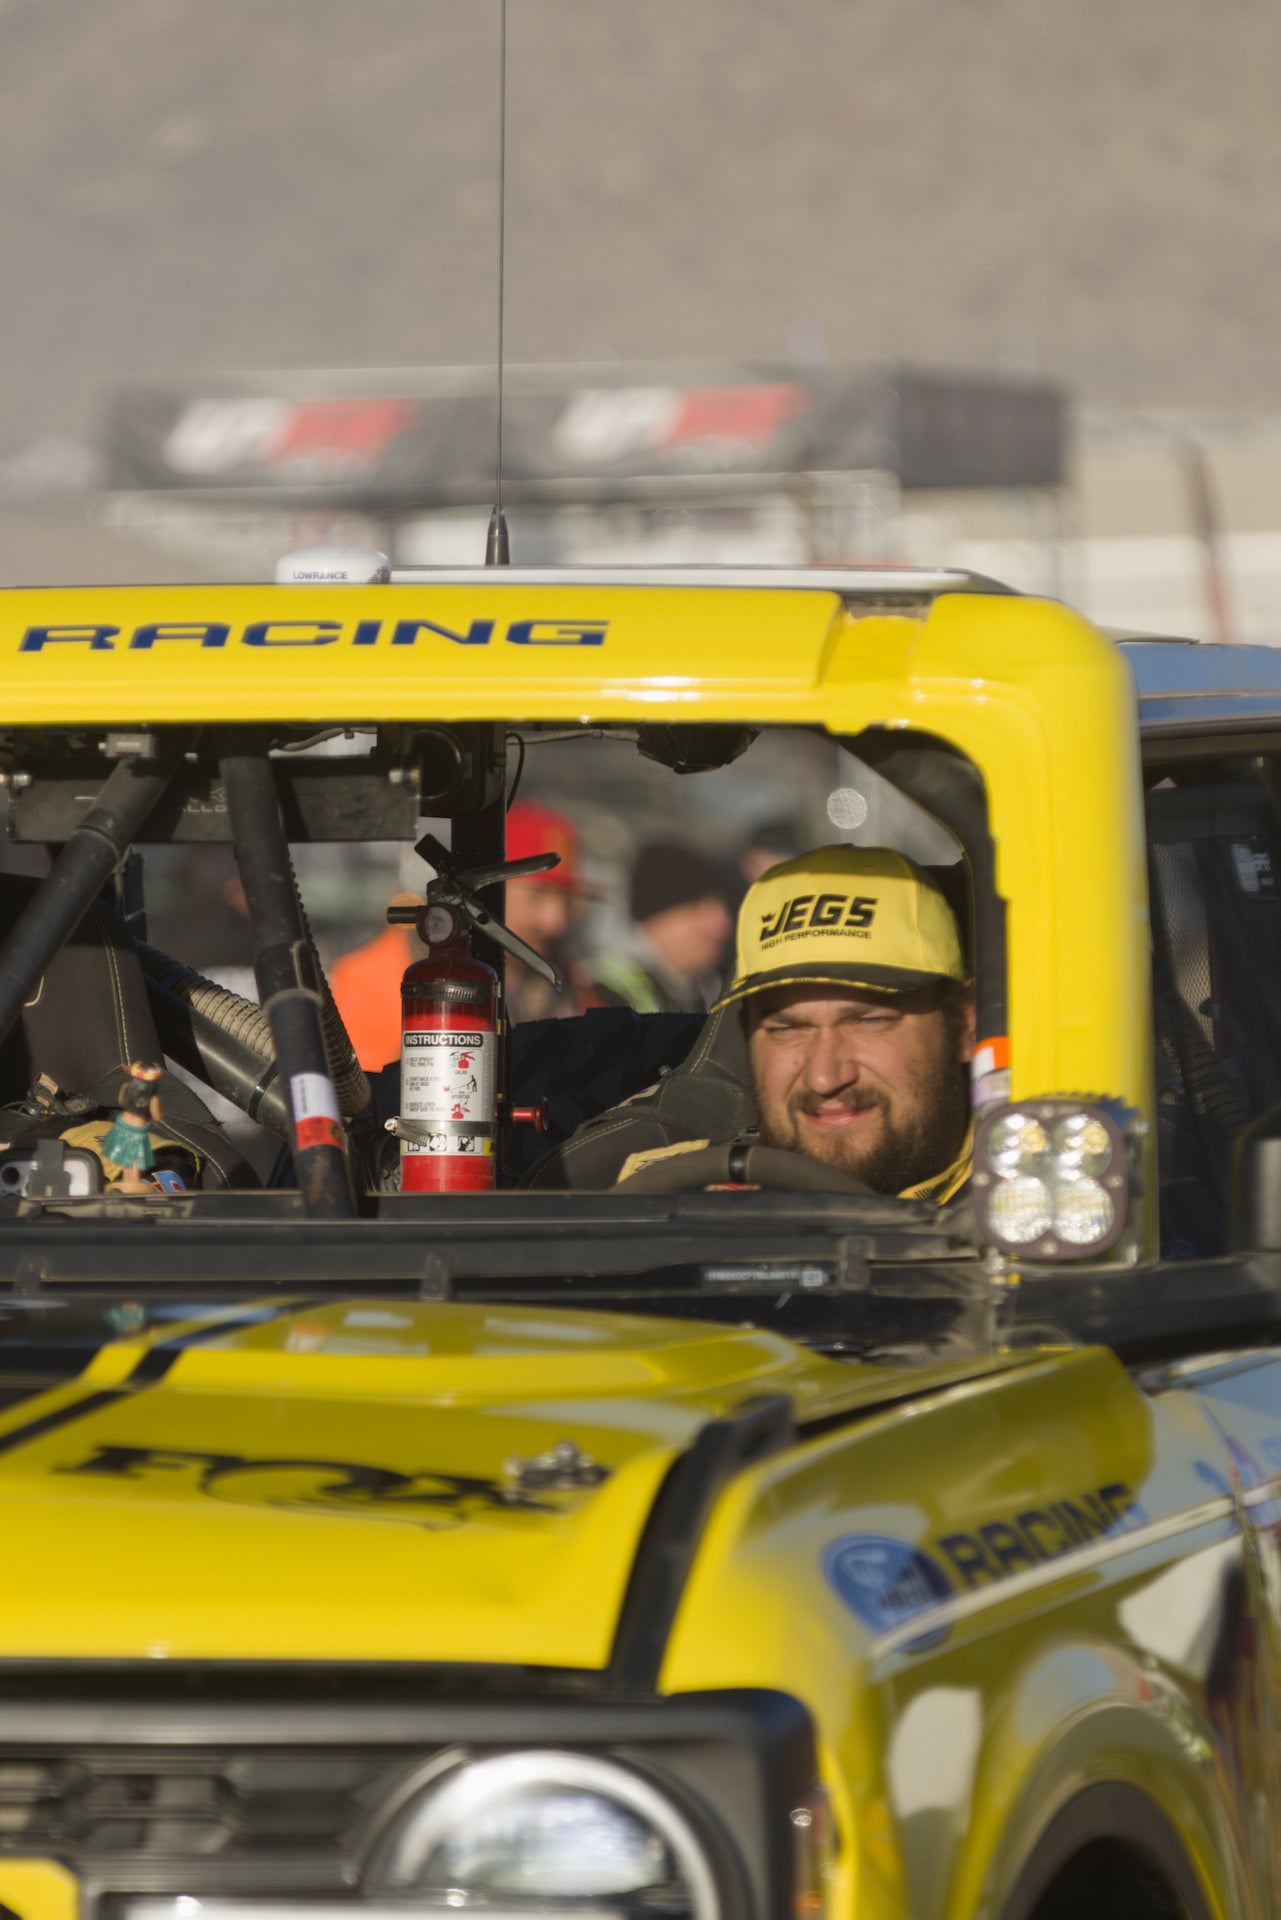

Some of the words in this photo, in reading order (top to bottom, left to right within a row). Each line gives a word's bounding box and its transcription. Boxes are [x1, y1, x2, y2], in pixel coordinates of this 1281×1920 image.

[293, 571, 348, 580] LOWRANCE
[18, 618, 610, 652] RACING
[759, 893, 879, 942] JEGS
[761, 937, 782, 952] HIGH
[784, 928, 872, 943] PERFORMANCE
[406, 1034, 481, 1046] INSTRUCTIONS
[937, 1483, 1150, 1592] RACING
